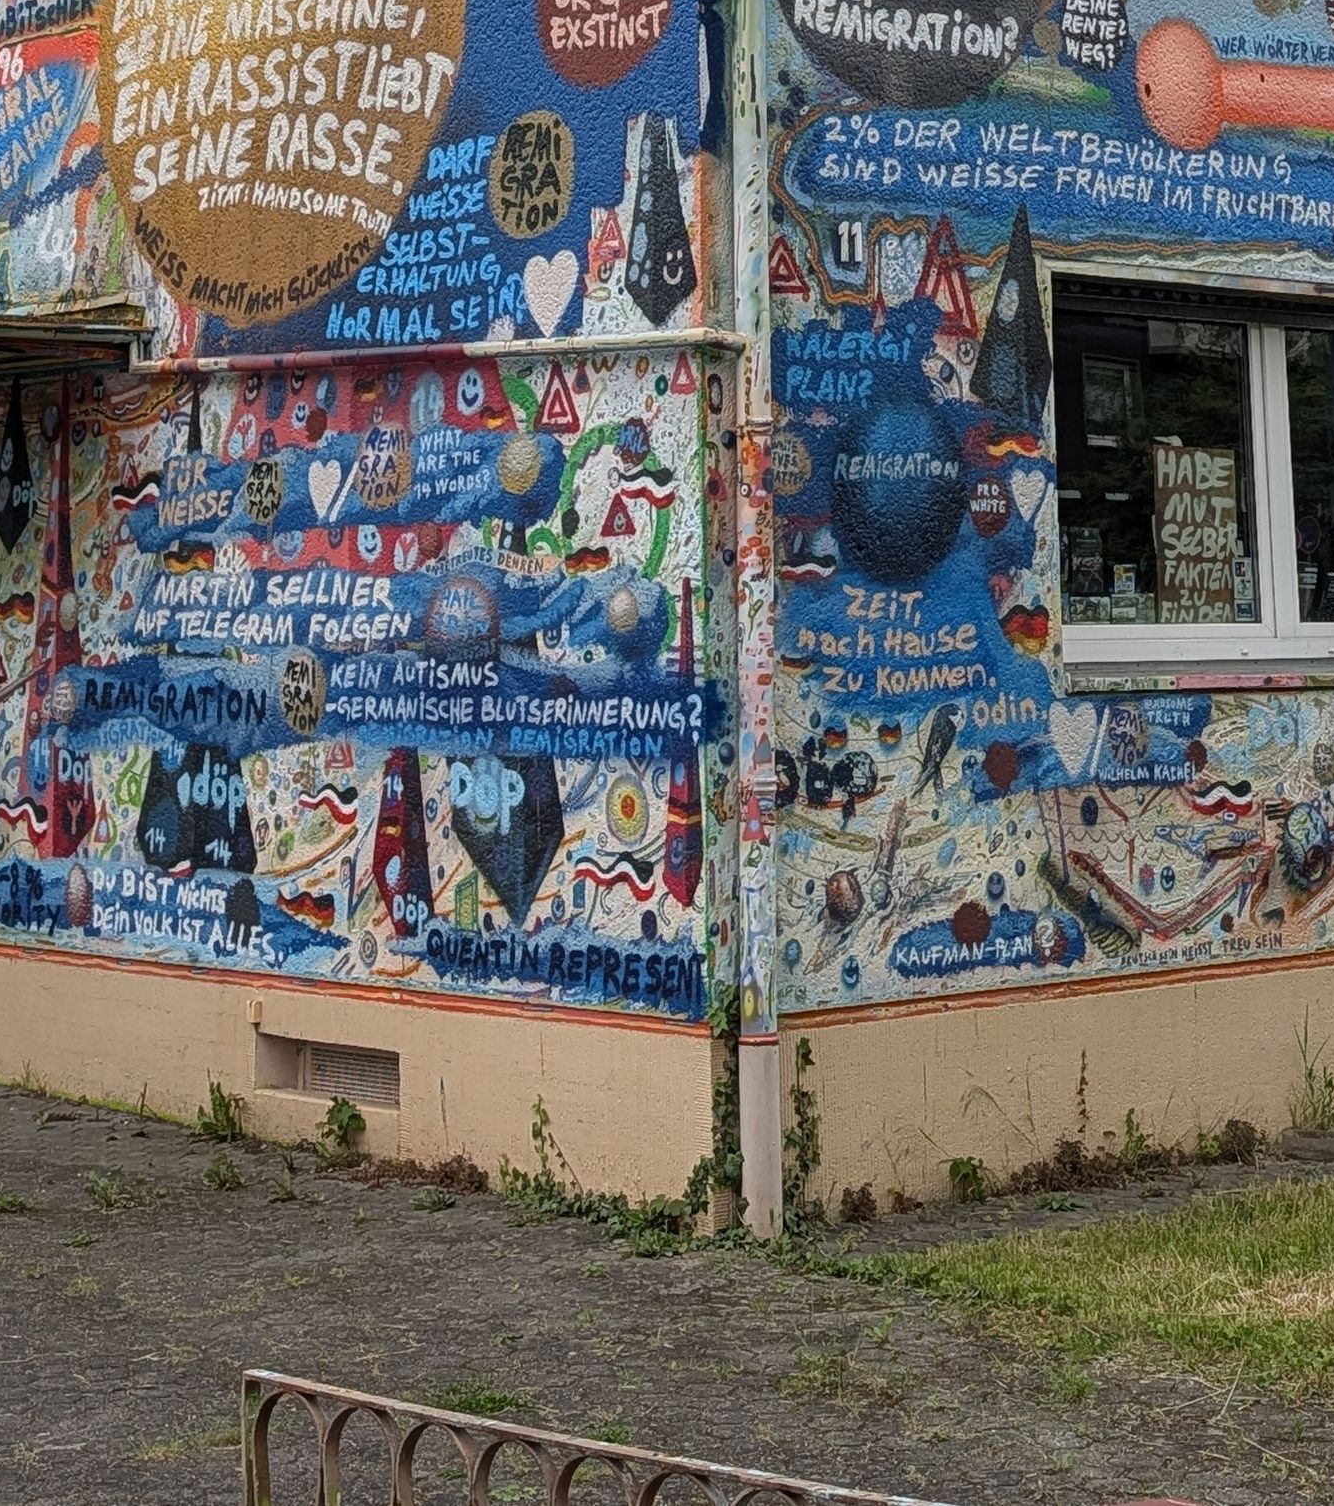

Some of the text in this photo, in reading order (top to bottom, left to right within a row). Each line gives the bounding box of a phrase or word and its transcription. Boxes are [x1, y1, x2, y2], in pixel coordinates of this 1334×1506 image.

[550, 2, 666, 50] EXSTINCT
[112, 41, 454, 145] EIN RASSIST LIEBT
[130, 118, 256, 203] SEINE
[427, 135, 495, 181] DARF
[824, 114, 1292, 184] 2% DER WELTBEVÖLKERUNG
[500, 161, 561, 198] GRA
[819, 154, 902, 185] SIND
[918, 158, 1044, 191] WEISSE
[1164, 180, 1193, 213] IM
[251, 181, 395, 240] HANDSOME TRUTH
[408, 179, 487, 222] WEISSE
[500, 200, 559, 233] TION
[135, 208, 283, 315] WEISS MACHT MICH
[356, 253, 500, 296] ERHALTUNG
[326, 303, 441, 344] NORMAL
[166, 455, 207, 490] FÜR
[834, 452, 960, 482] REMIGRATION
[1157, 448, 1234, 490] HABE
[159, 489, 233, 527] WEISSE
[970, 498, 1006, 514] WHITE
[1164, 492, 1235, 530] MUT
[1161, 522, 1243, 560] SELBER
[153, 572, 394, 611] MARTIN SELLNER
[1164, 560, 1233, 591] FAKTEN
[1160, 601, 1233, 623] FINDEN
[1181, 590, 1206, 607] ZU
[134, 608, 170, 636] AUF
[175, 612, 294, 647] TELEGRAM
[307, 612, 414, 651] FOLGEN
[330, 661, 499, 689] KEIN AUTISMUS
[85, 678, 267, 725] REMIGRATION
[509, 728, 666, 756] REMIGRATION
[92, 868, 115, 891] DU
[122, 869, 174, 905] BIST
[92, 904, 131, 932] DEIN
[133, 909, 173, 938] VOLK
[177, 909, 202, 942] IST
[426, 928, 706, 999] QUENTIN REPRESENT
